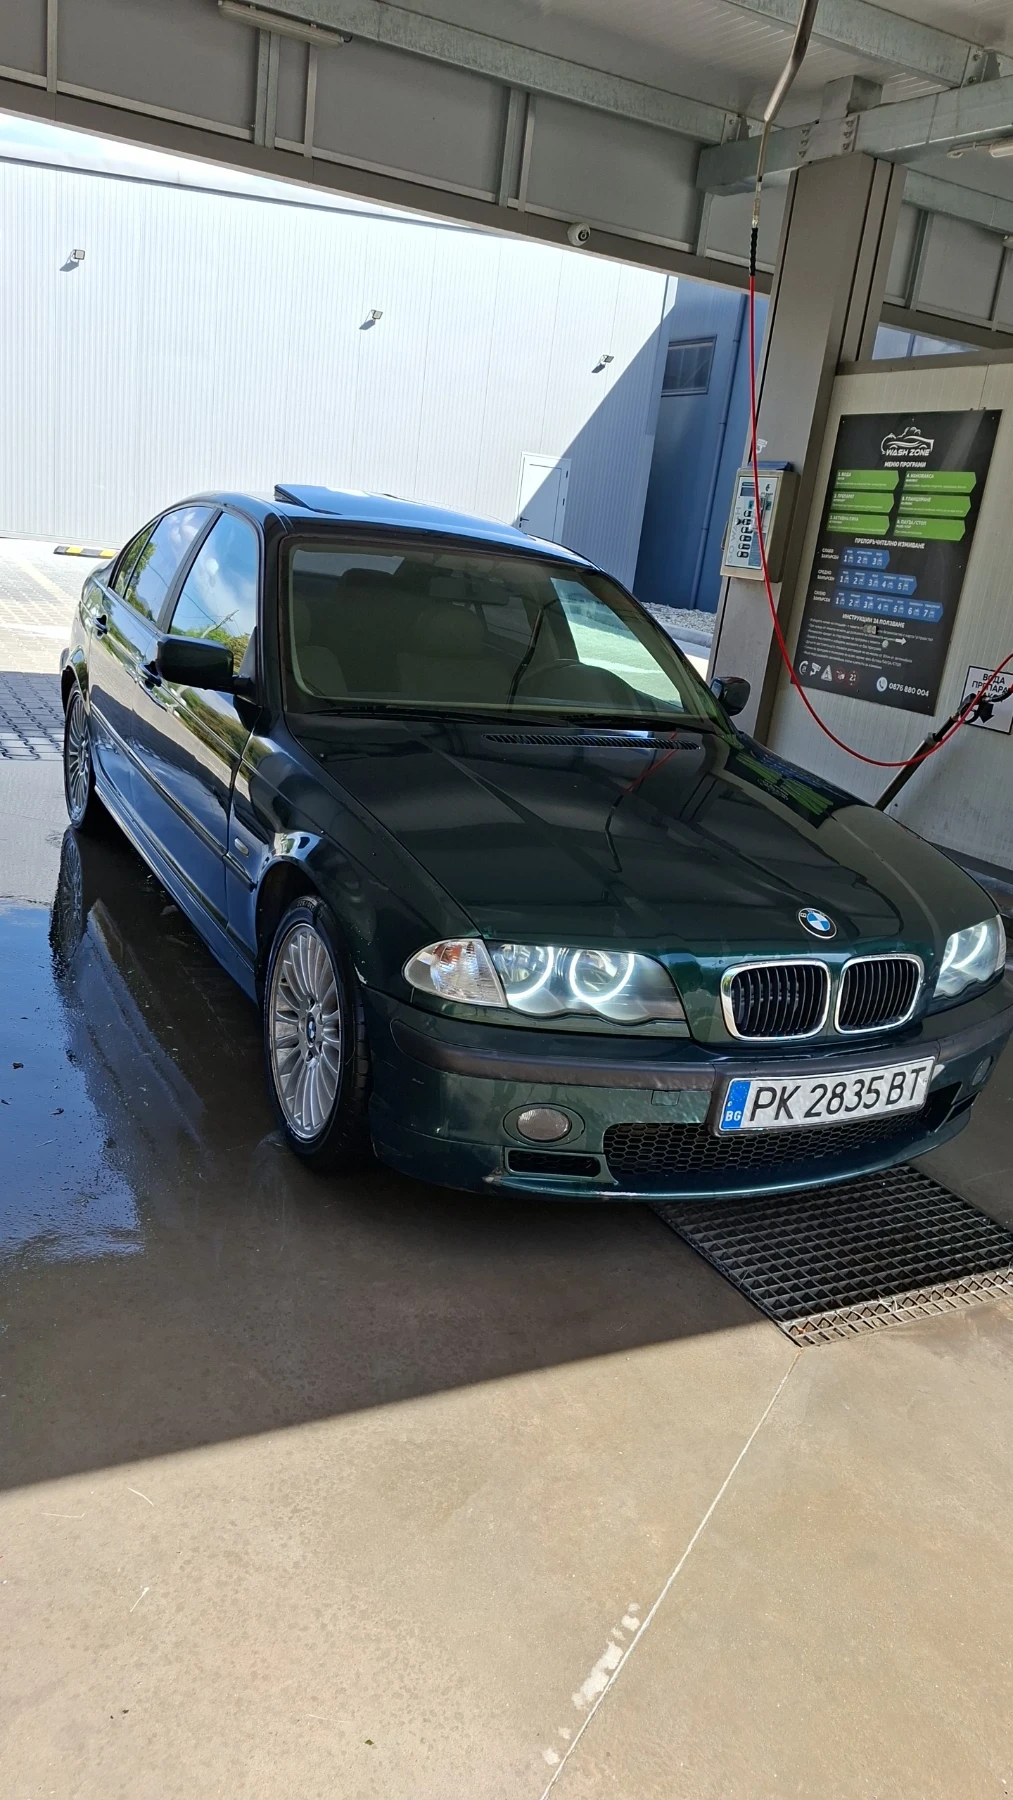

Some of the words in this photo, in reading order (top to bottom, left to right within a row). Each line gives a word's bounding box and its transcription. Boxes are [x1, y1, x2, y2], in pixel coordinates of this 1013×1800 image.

[842, 613, 873, 623] ИНСТРУКЦИИ
[879, 619, 905, 628] ПОЛЗВАНЕ
[888, 682, 904, 692] 0876
[904, 685, 916, 694] 880
[916, 688, 930, 697] 004
[972, 680, 1009, 694] ПРПАРА
[749, 1085, 802, 1122] PK
[803, 1075, 885, 1119] 2835
[885, 1066, 927, 1106] BT
[724, 1110, 742, 1122] BG
